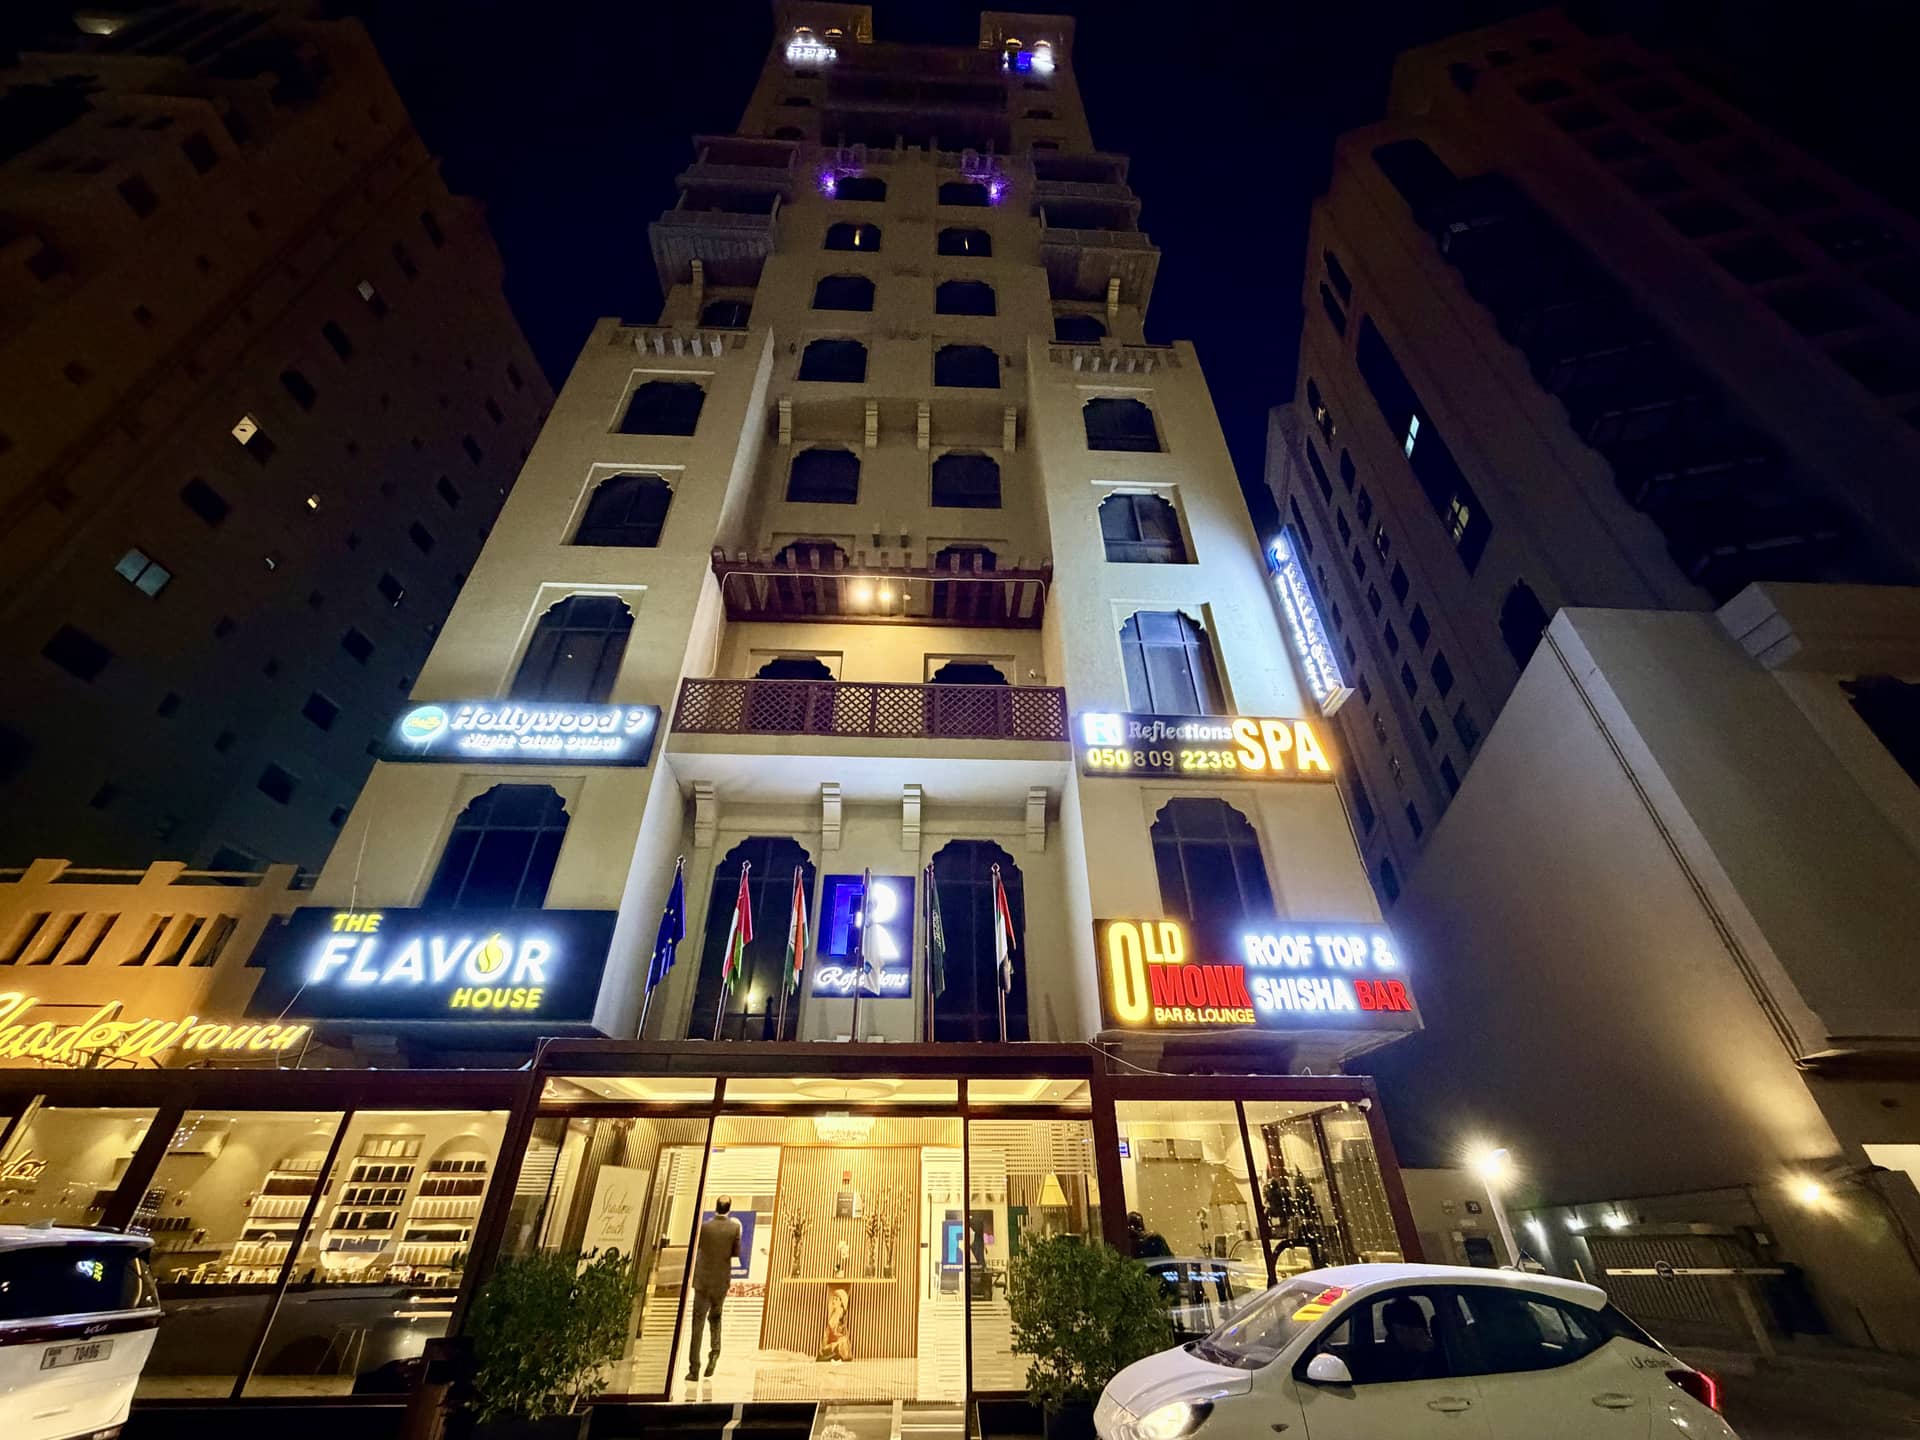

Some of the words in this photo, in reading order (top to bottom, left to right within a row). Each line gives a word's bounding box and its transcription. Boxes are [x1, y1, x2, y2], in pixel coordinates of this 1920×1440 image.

[450, 706, 621, 735] Hollywood
[625, 708, 647, 734] 9
[1129, 720, 1232, 742] Reflections
[518, 733, 563, 750] Club
[1231, 718, 1332, 771] SPA
[1087, 748, 1130, 769] 050
[1180, 751, 1237, 770] 2238
[332, 912, 383, 933] THE
[310, 934, 551, 984] FLAVOR
[1243, 935, 1314, 967] ROOF
[1315, 936, 1367, 968] TOP
[1371, 937, 1396, 969] &
[1108, 921, 1185, 1023] OLD
[1149, 964, 1253, 1007] MONK
[449, 986, 545, 1009] HOUSE
[1252, 977, 1355, 1012] SHISHA
[1353, 979, 1413, 1012] BAR
[1154, 1007, 1183, 1022] BAR
[1184, 1008, 1197, 1023] &
[1198, 1008, 1256, 1024] LOUNGE
